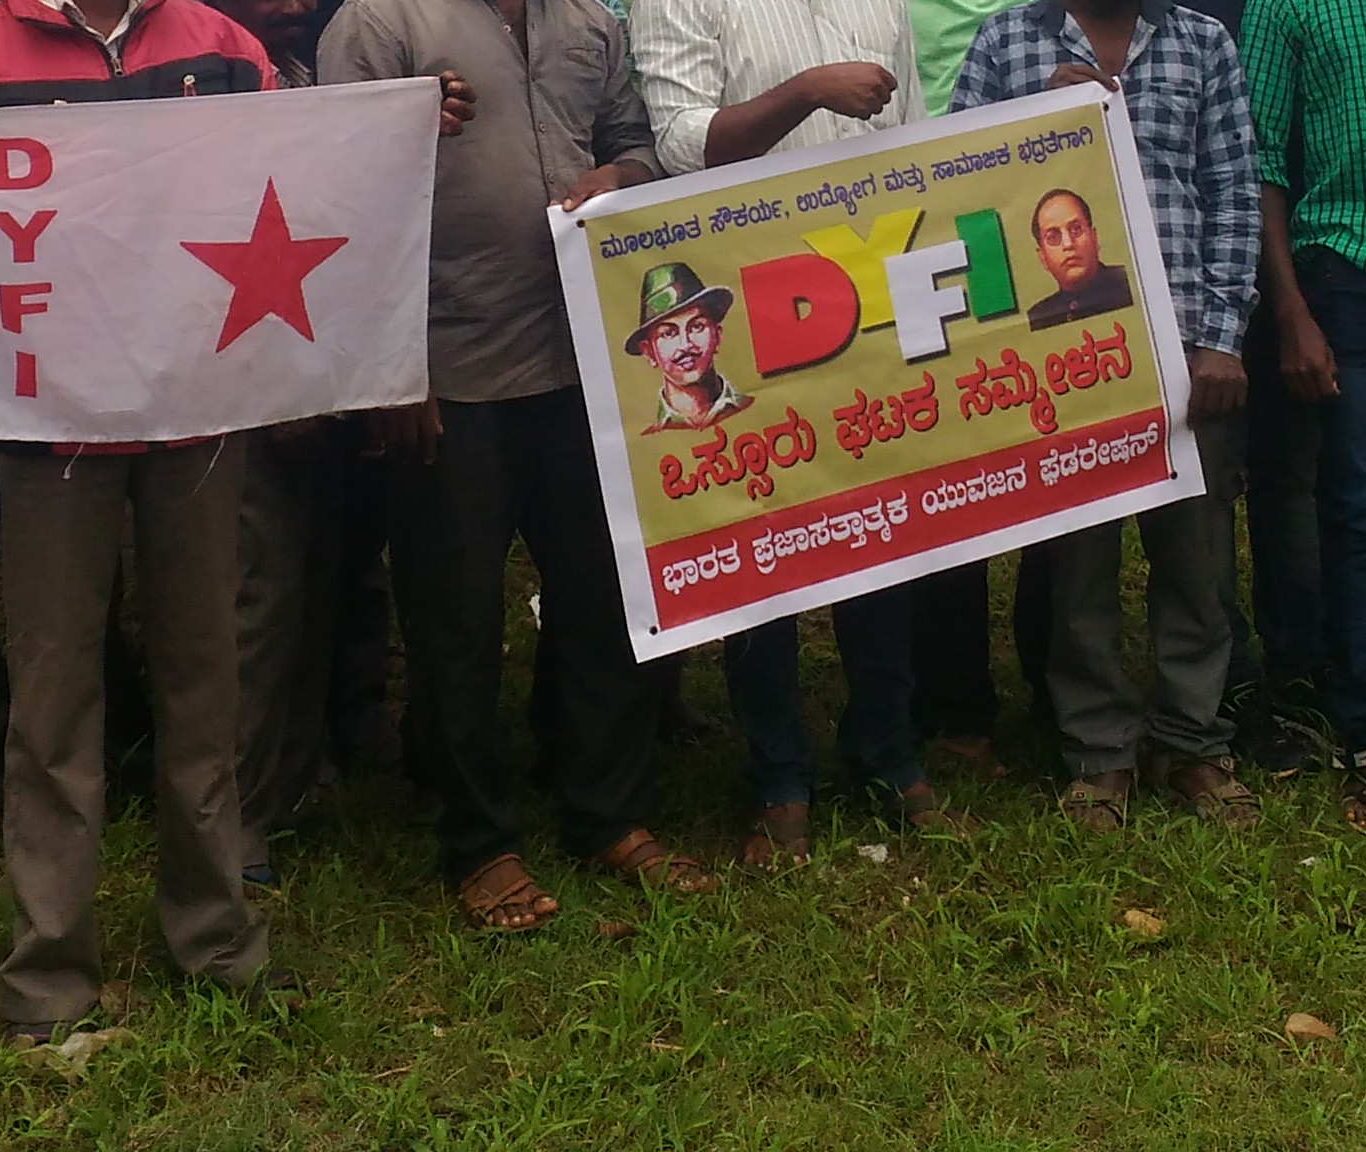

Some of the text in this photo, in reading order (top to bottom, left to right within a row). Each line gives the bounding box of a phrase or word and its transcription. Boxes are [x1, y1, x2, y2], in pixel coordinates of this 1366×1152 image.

[600, 214, 702, 259] ಮೂಲಭೂತ
[796, 172, 877, 216] ಉದ್ಯೋಗ
[883, 163, 927, 194] ಮತ್ತು
[930, 142, 1011, 182] ಸಾಮಾಜಿಕ
[1017, 125, 1094, 164] ಭದ್ರತೆಗಾಗಿ
[740, 207, 1018, 378] DYFI
[659, 321, 1132, 501] ಒಸ್ಸೂರು ಘಟಕ ಸಮ್ಮೇಳನ
[662, 538, 741, 595] ಭಾರತ
[751, 490, 910, 576] ಪ್ರಜಾಸತ್ತಾತ್ಮಕ
[921, 457, 1028, 516] ಯುವಜನ
